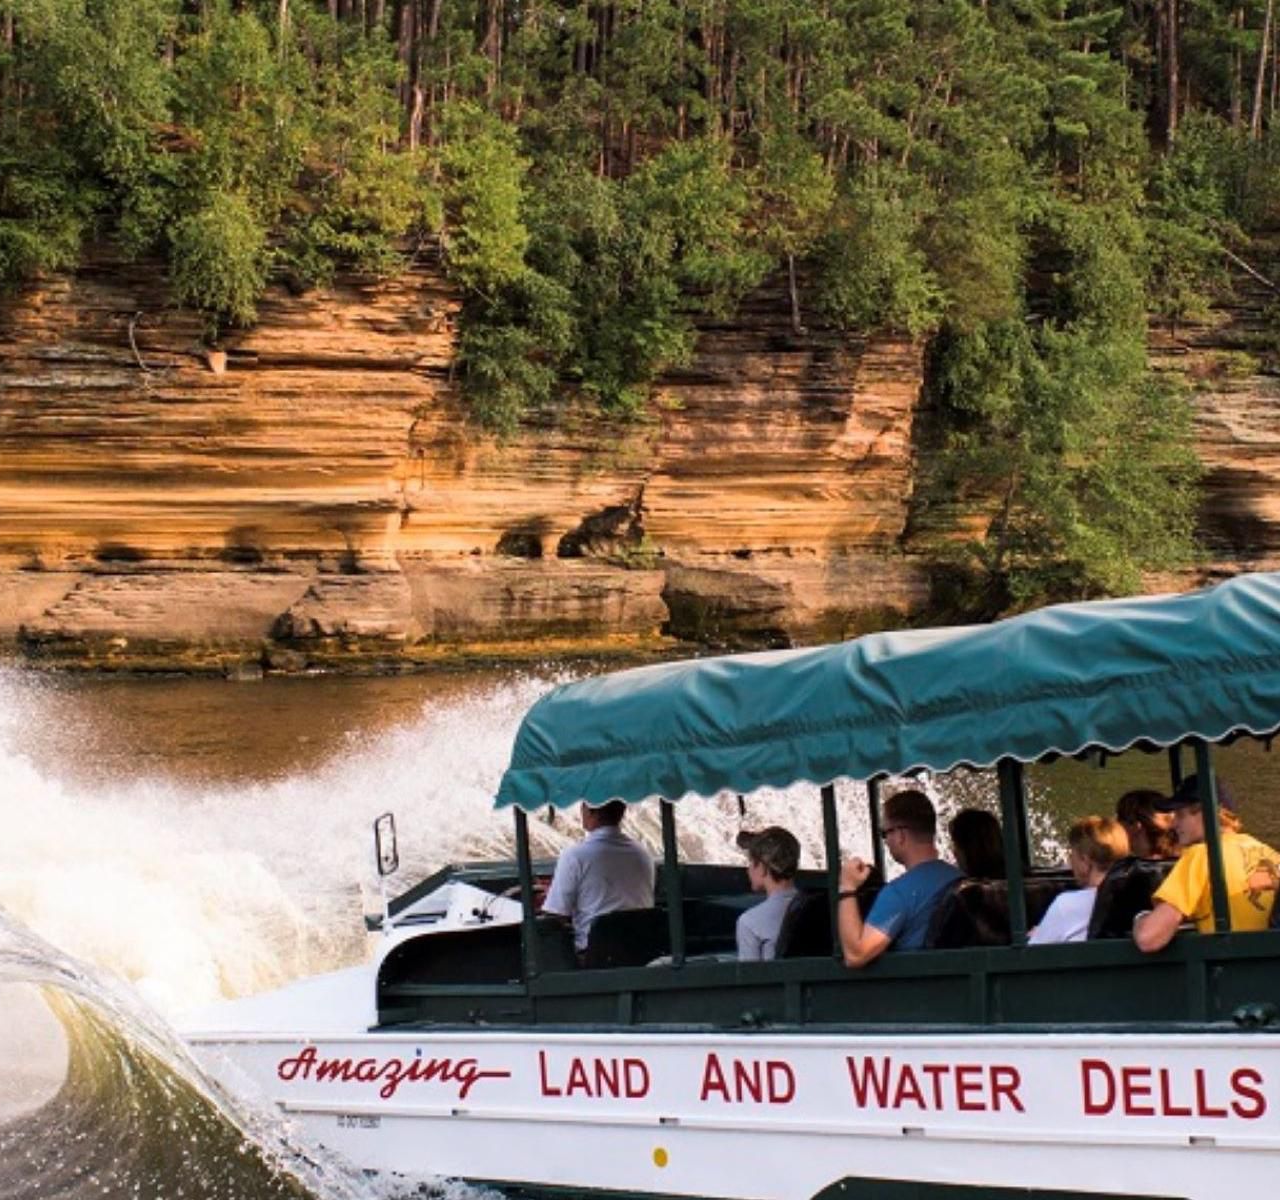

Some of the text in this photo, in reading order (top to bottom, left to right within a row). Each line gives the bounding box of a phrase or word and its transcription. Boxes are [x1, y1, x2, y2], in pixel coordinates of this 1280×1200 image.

[277, 1047, 510, 1099] Amazing
[539, 1050, 651, 1099] LAND
[699, 1053, 796, 1104] AND
[847, 1055, 1025, 1112] WATER
[1080, 1058, 1266, 1120] DELLS
